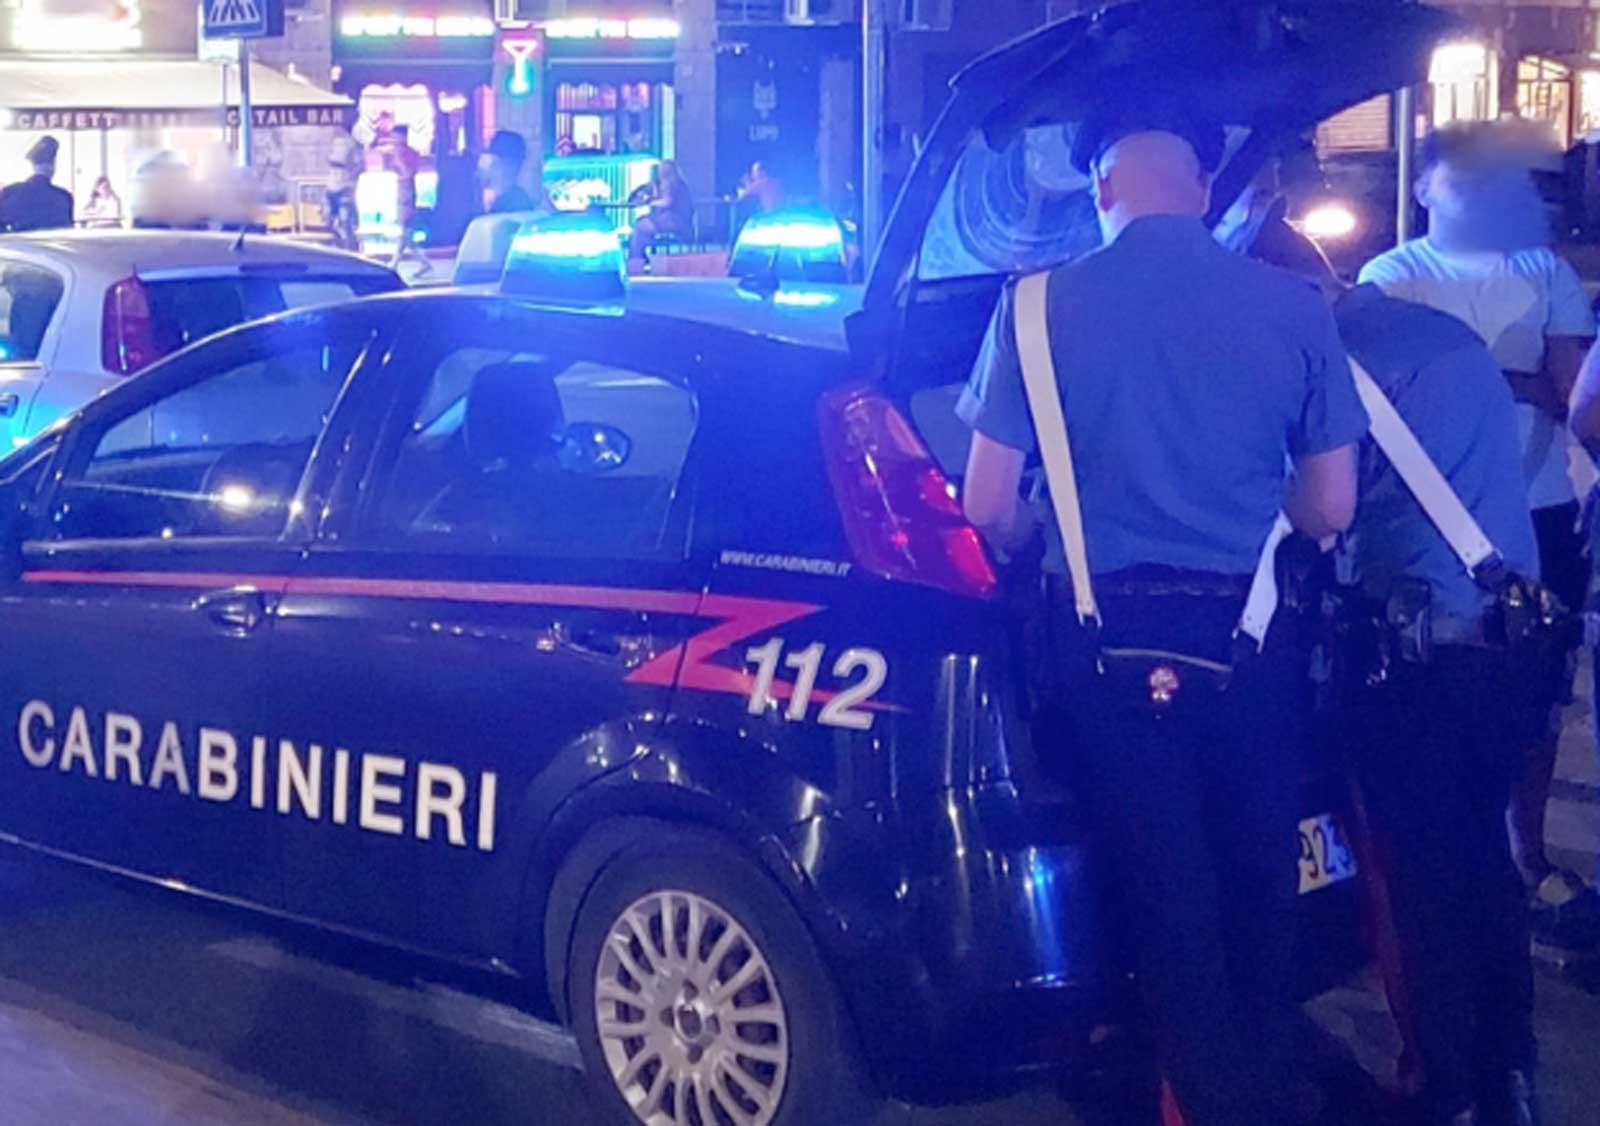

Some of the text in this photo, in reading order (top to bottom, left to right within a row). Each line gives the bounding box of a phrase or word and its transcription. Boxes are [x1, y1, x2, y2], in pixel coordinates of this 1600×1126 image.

[306, 109, 343, 124] BAR
[744, 637, 888, 730] 112
[18, 699, 498, 851] CARABINIERI
